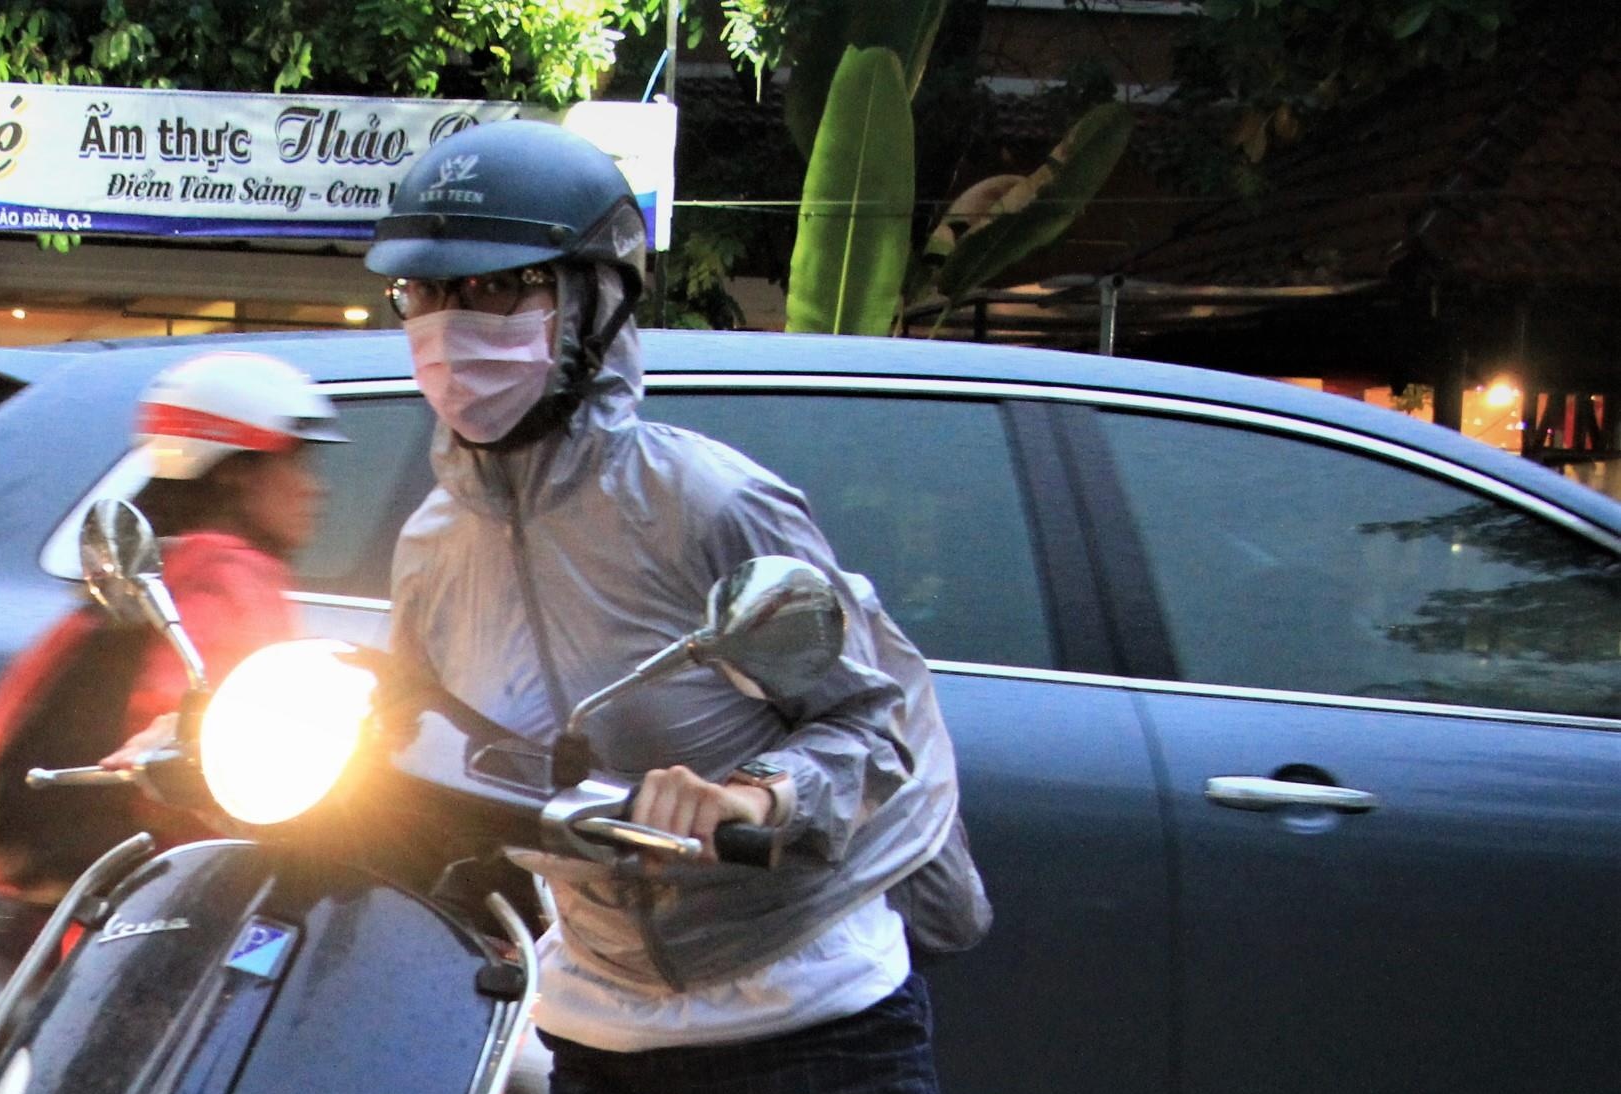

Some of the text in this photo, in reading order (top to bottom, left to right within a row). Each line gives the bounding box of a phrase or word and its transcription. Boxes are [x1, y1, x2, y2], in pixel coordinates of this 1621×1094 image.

[79, 102, 146, 160] Ẩm
[158, 116, 253, 171] thực
[276, 105, 413, 163] Thảo
[107, 168, 174, 201] Điểm
[180, 174, 237, 203] Tâm
[326, 179, 382, 207] Cơm
[67, 214, 92, 229] Q.2
